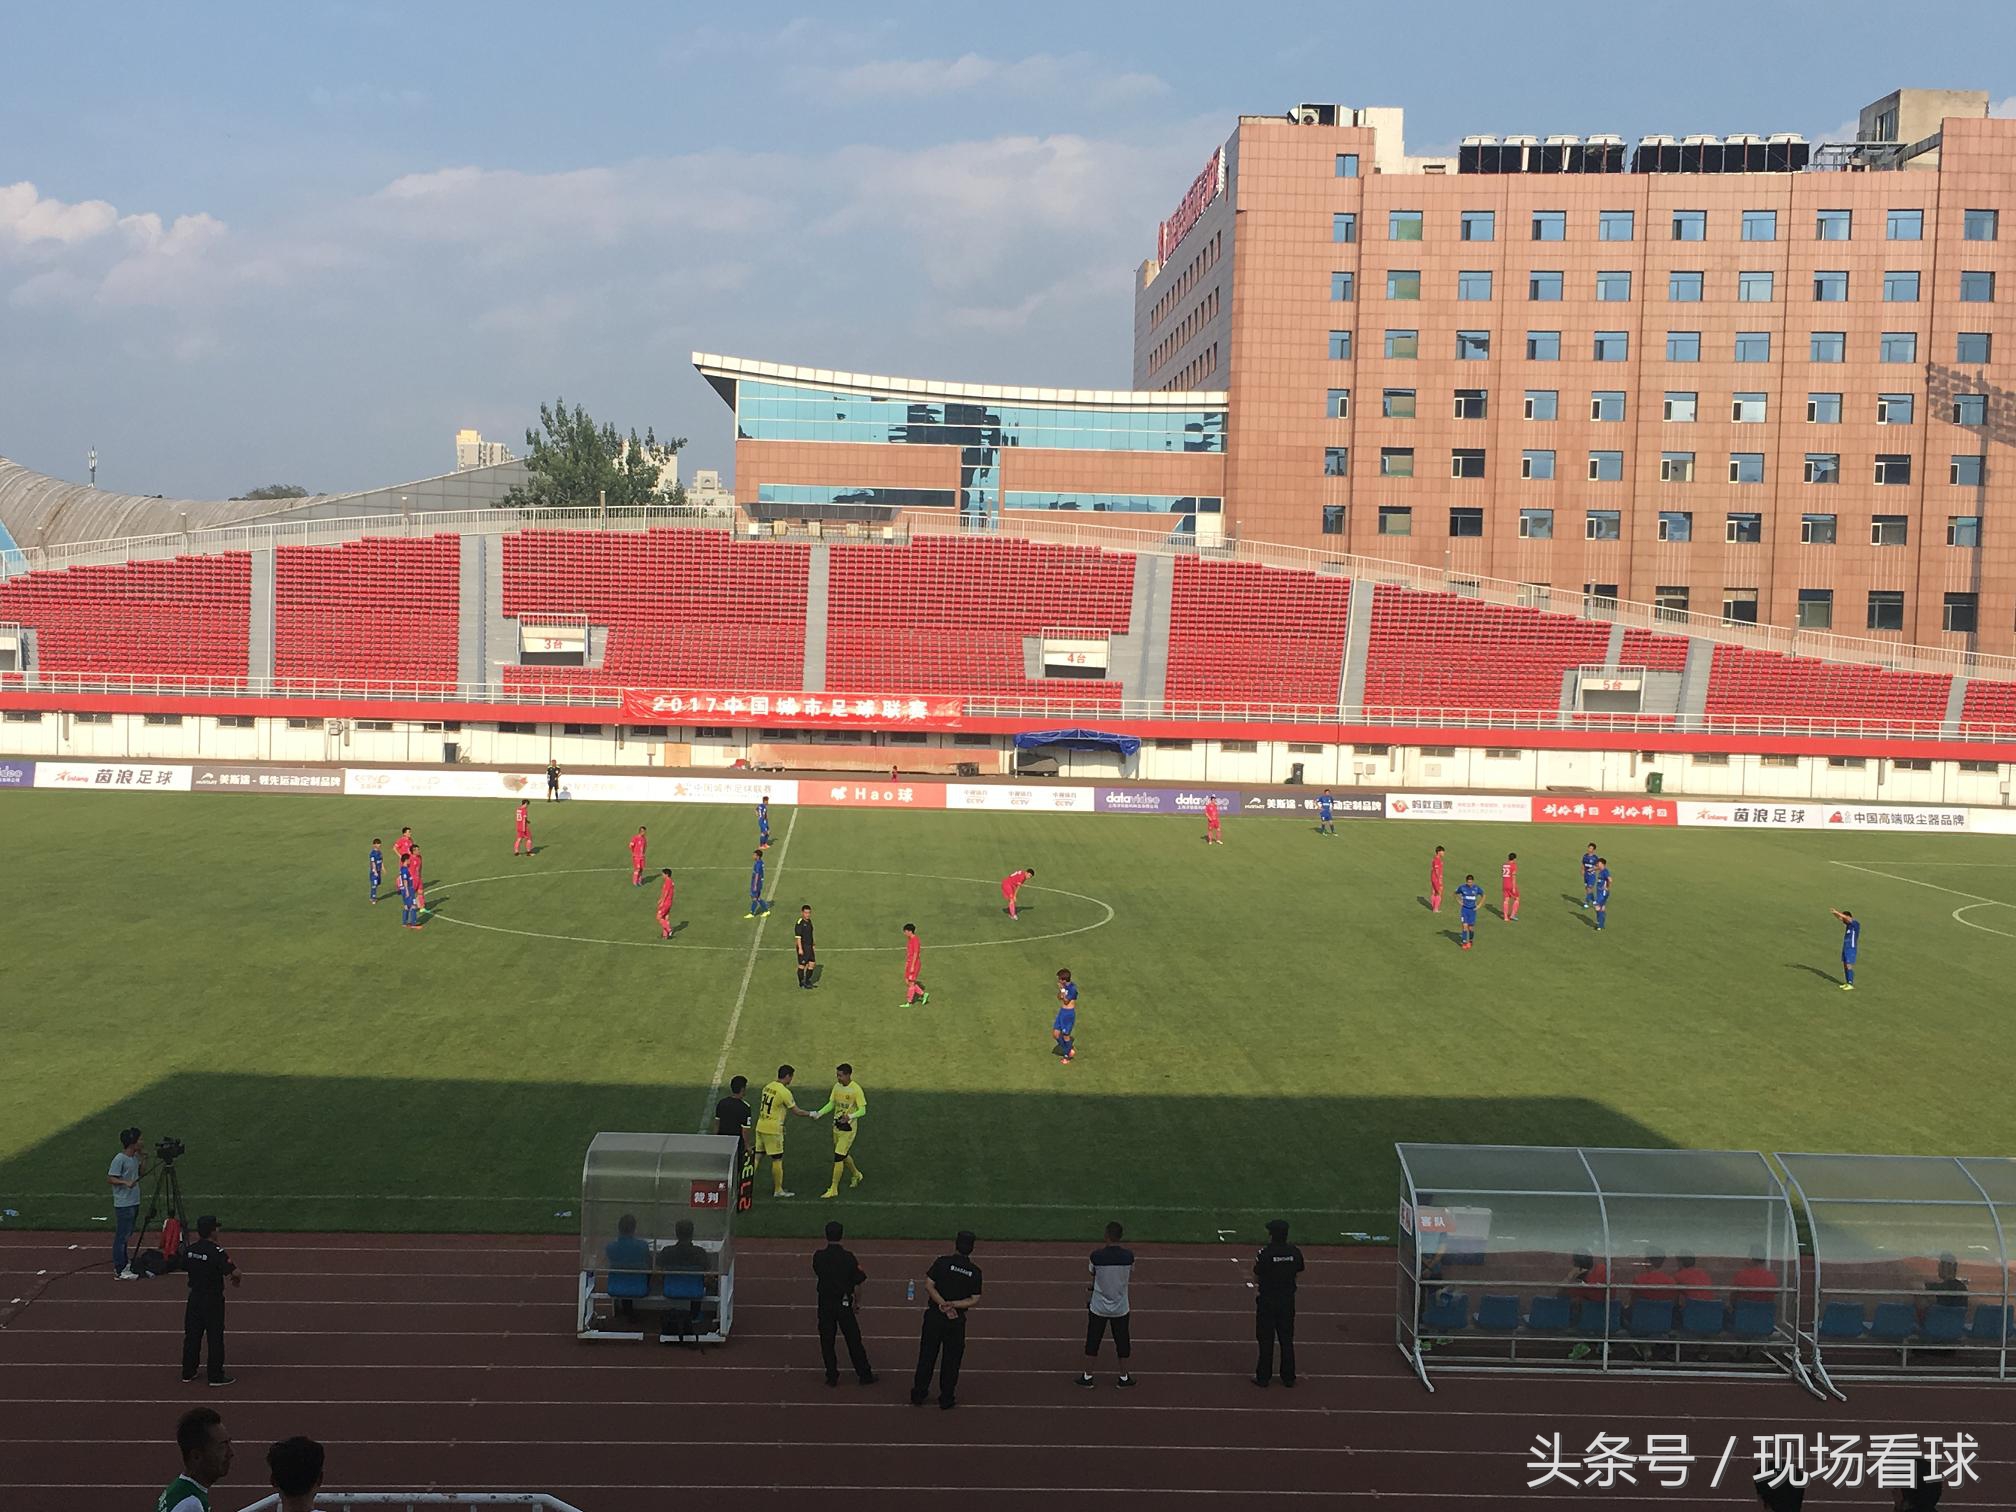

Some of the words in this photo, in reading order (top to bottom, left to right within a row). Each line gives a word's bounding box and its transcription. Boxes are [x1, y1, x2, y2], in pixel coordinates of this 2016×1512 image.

[1067, 653, 1086, 664] 4台
[95, 769, 173, 785] 茵浪足球
[855, 787, 913, 803] Hao球
[1106, 792, 1160, 805] datavideo
[1734, 808, 1805, 824] 茵浪足球
[1854, 811, 1965, 826] 中国高端吸尘器品牌
[1420, 1216, 1446, 1228] 客队
